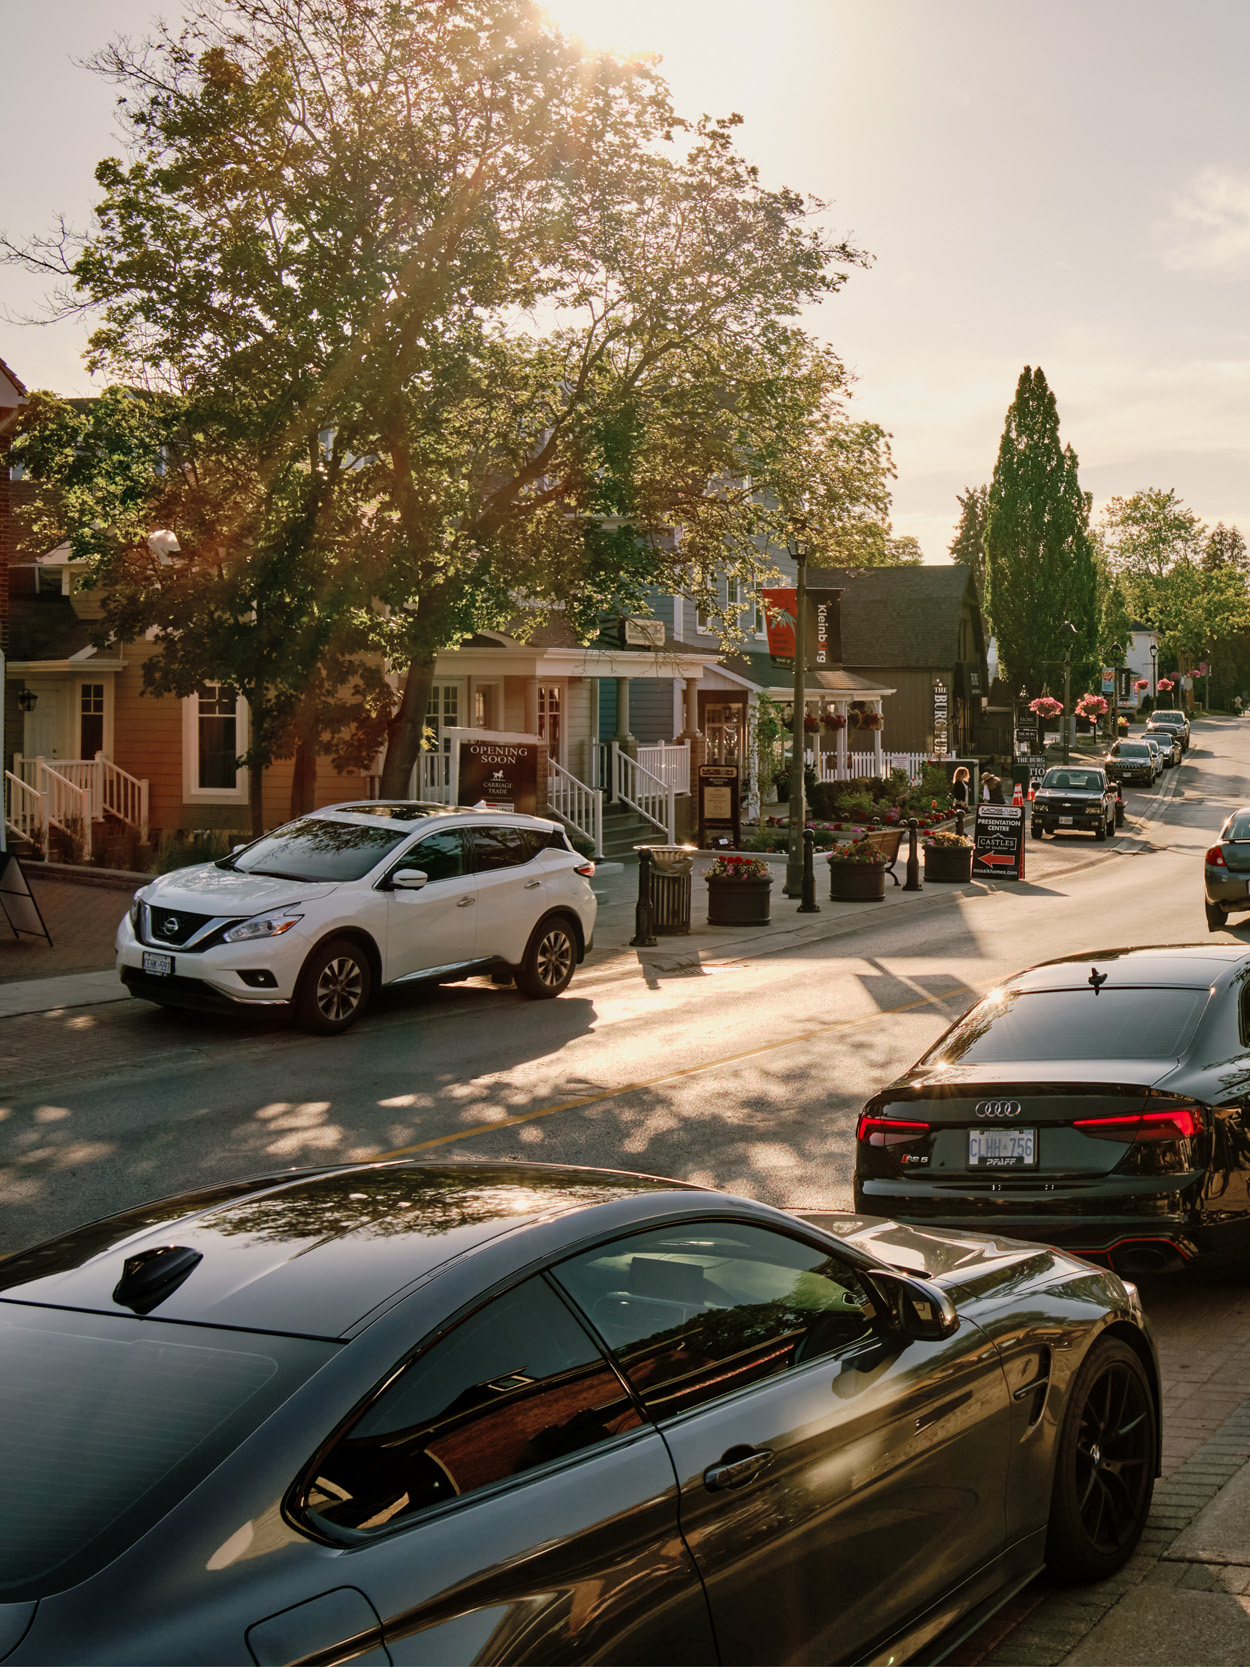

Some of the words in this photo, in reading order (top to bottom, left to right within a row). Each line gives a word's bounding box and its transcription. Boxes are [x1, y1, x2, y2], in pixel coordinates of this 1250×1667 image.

[934, 694, 948, 727] BURG
[934, 731, 948, 755] PUB
[470, 745, 528, 756] OPENING
[481, 754, 516, 764] SOON
[483, 781, 512, 789] CARRIAGE
[986, 1158, 1017, 1166] PFAFF
